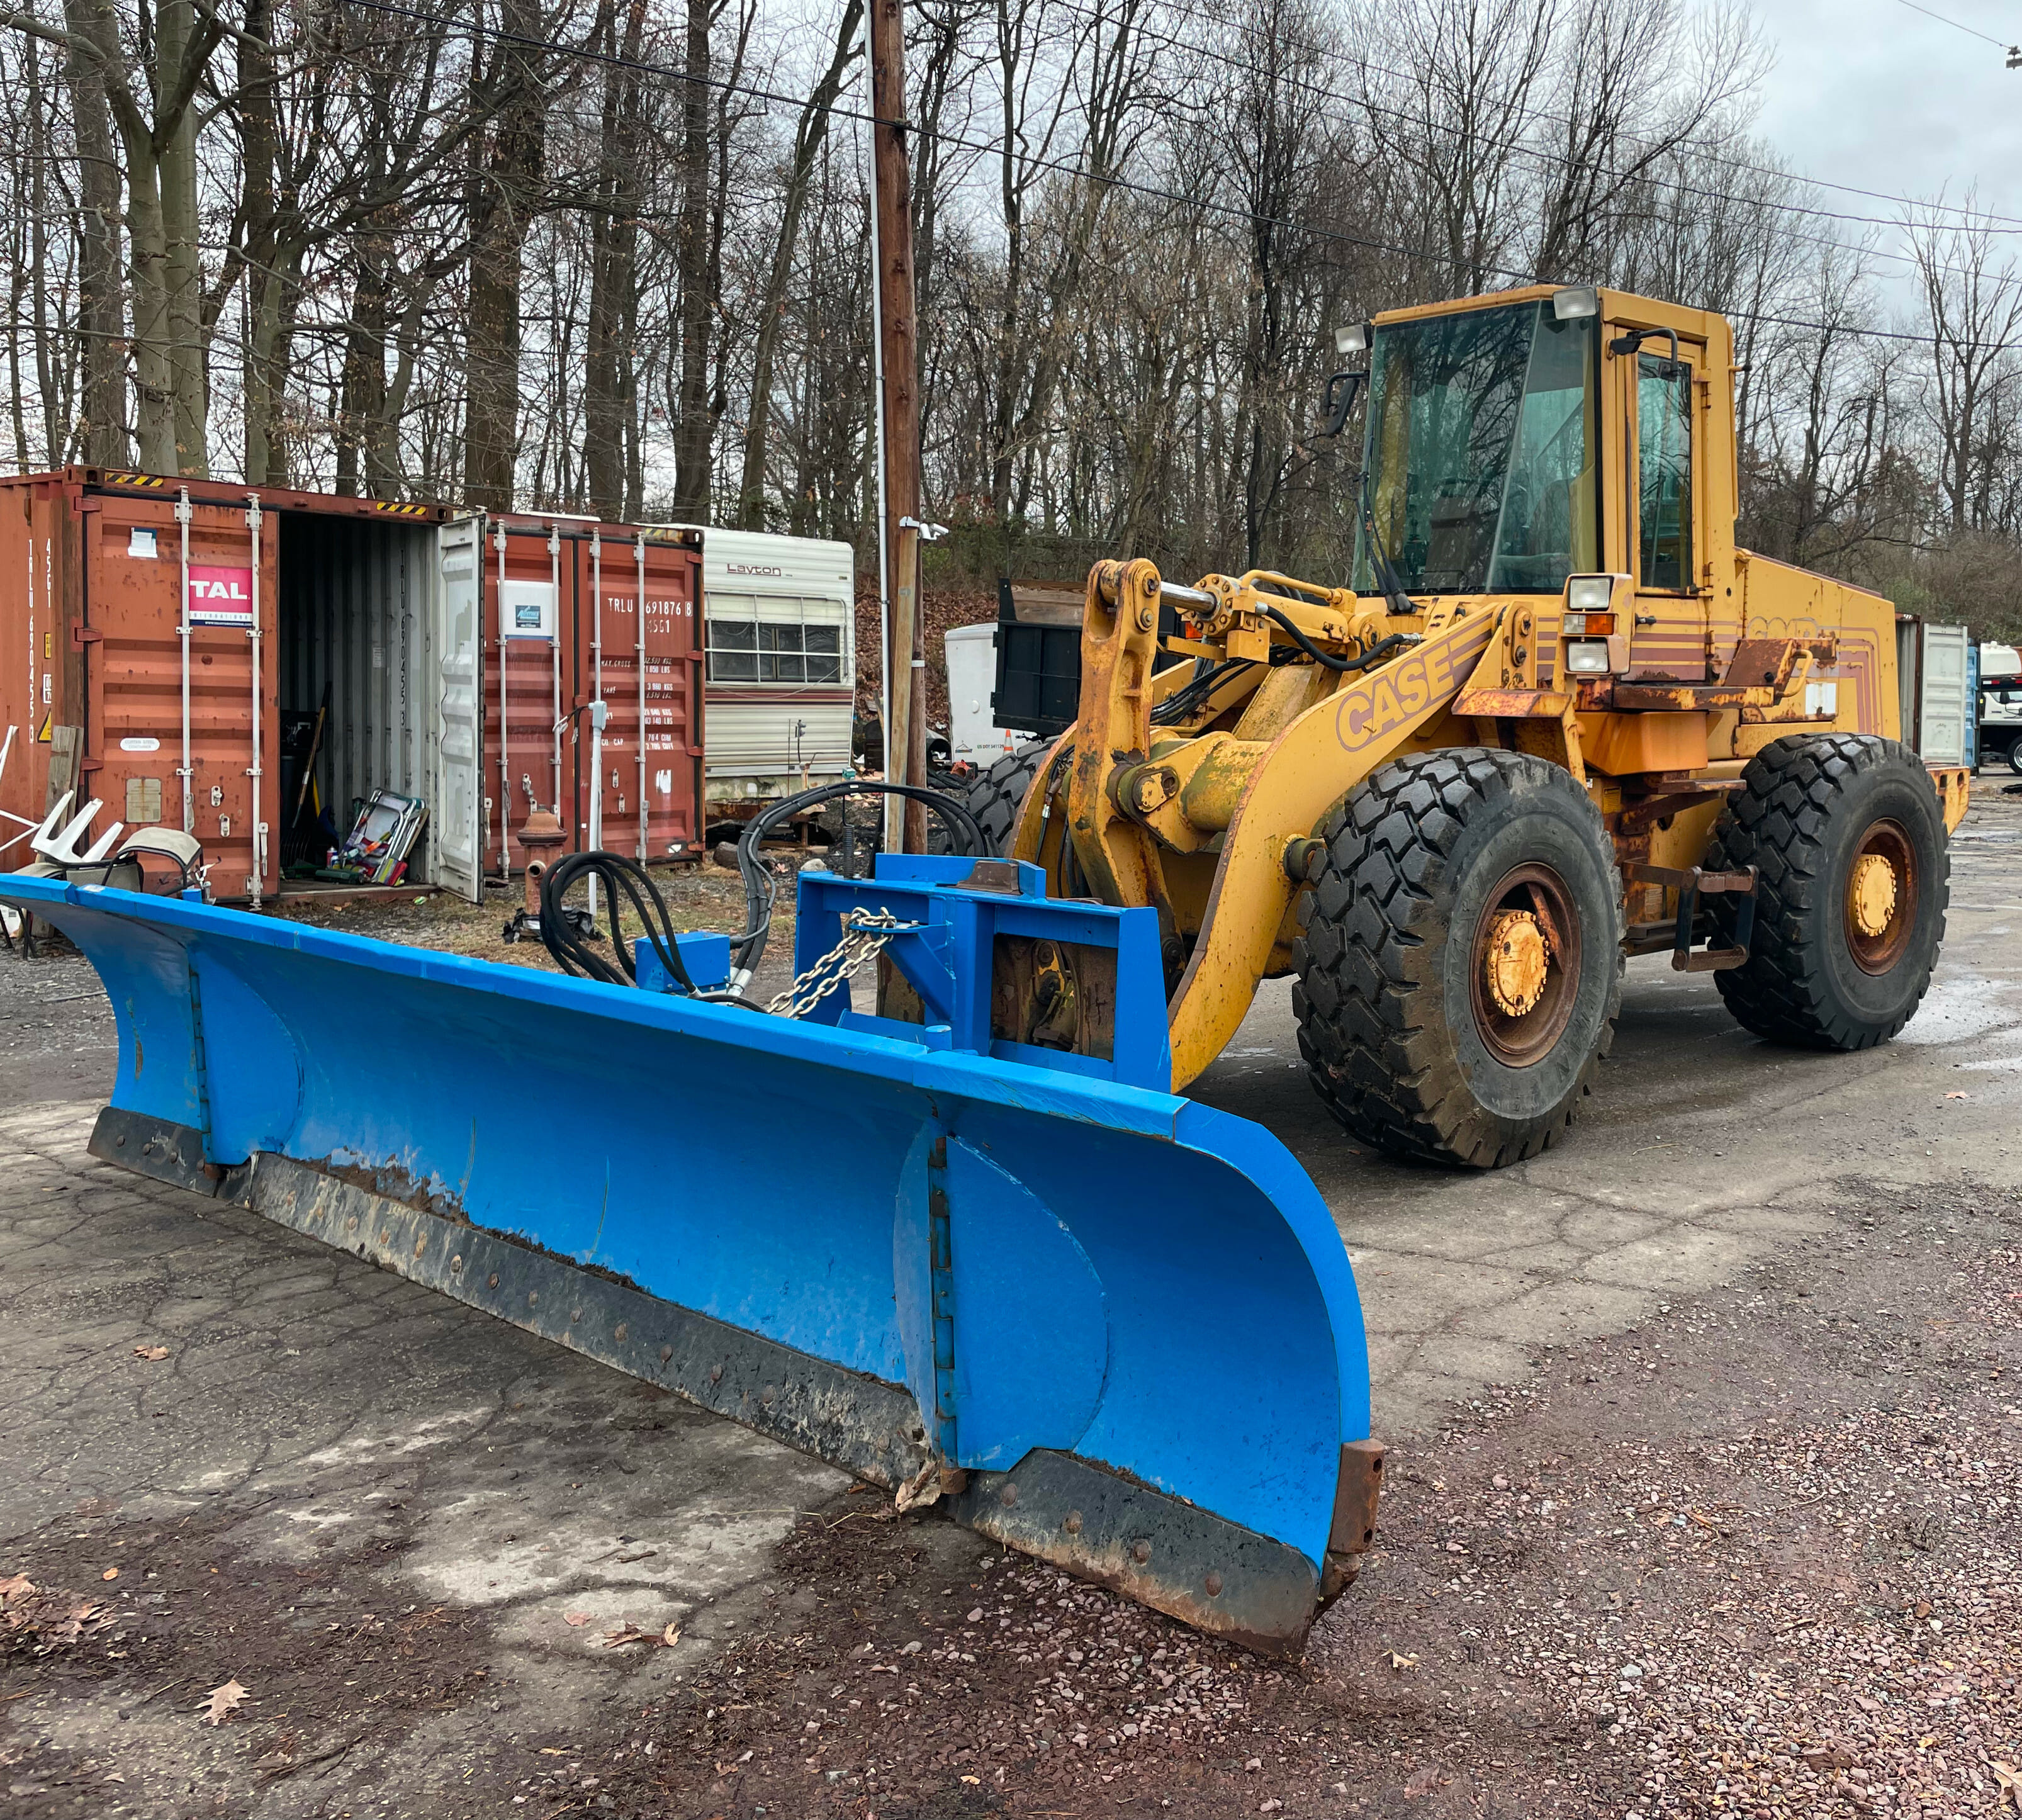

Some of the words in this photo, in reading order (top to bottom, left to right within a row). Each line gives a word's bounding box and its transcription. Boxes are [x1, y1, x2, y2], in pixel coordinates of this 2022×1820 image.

[727, 563, 781, 576] Layton
[189, 580, 248, 600] TAL
[608, 598, 633, 612] TRLU
[646, 601, 681, 615] 691876
[685, 602, 692, 616] 8
[1337, 642, 1455, 750] CASE
